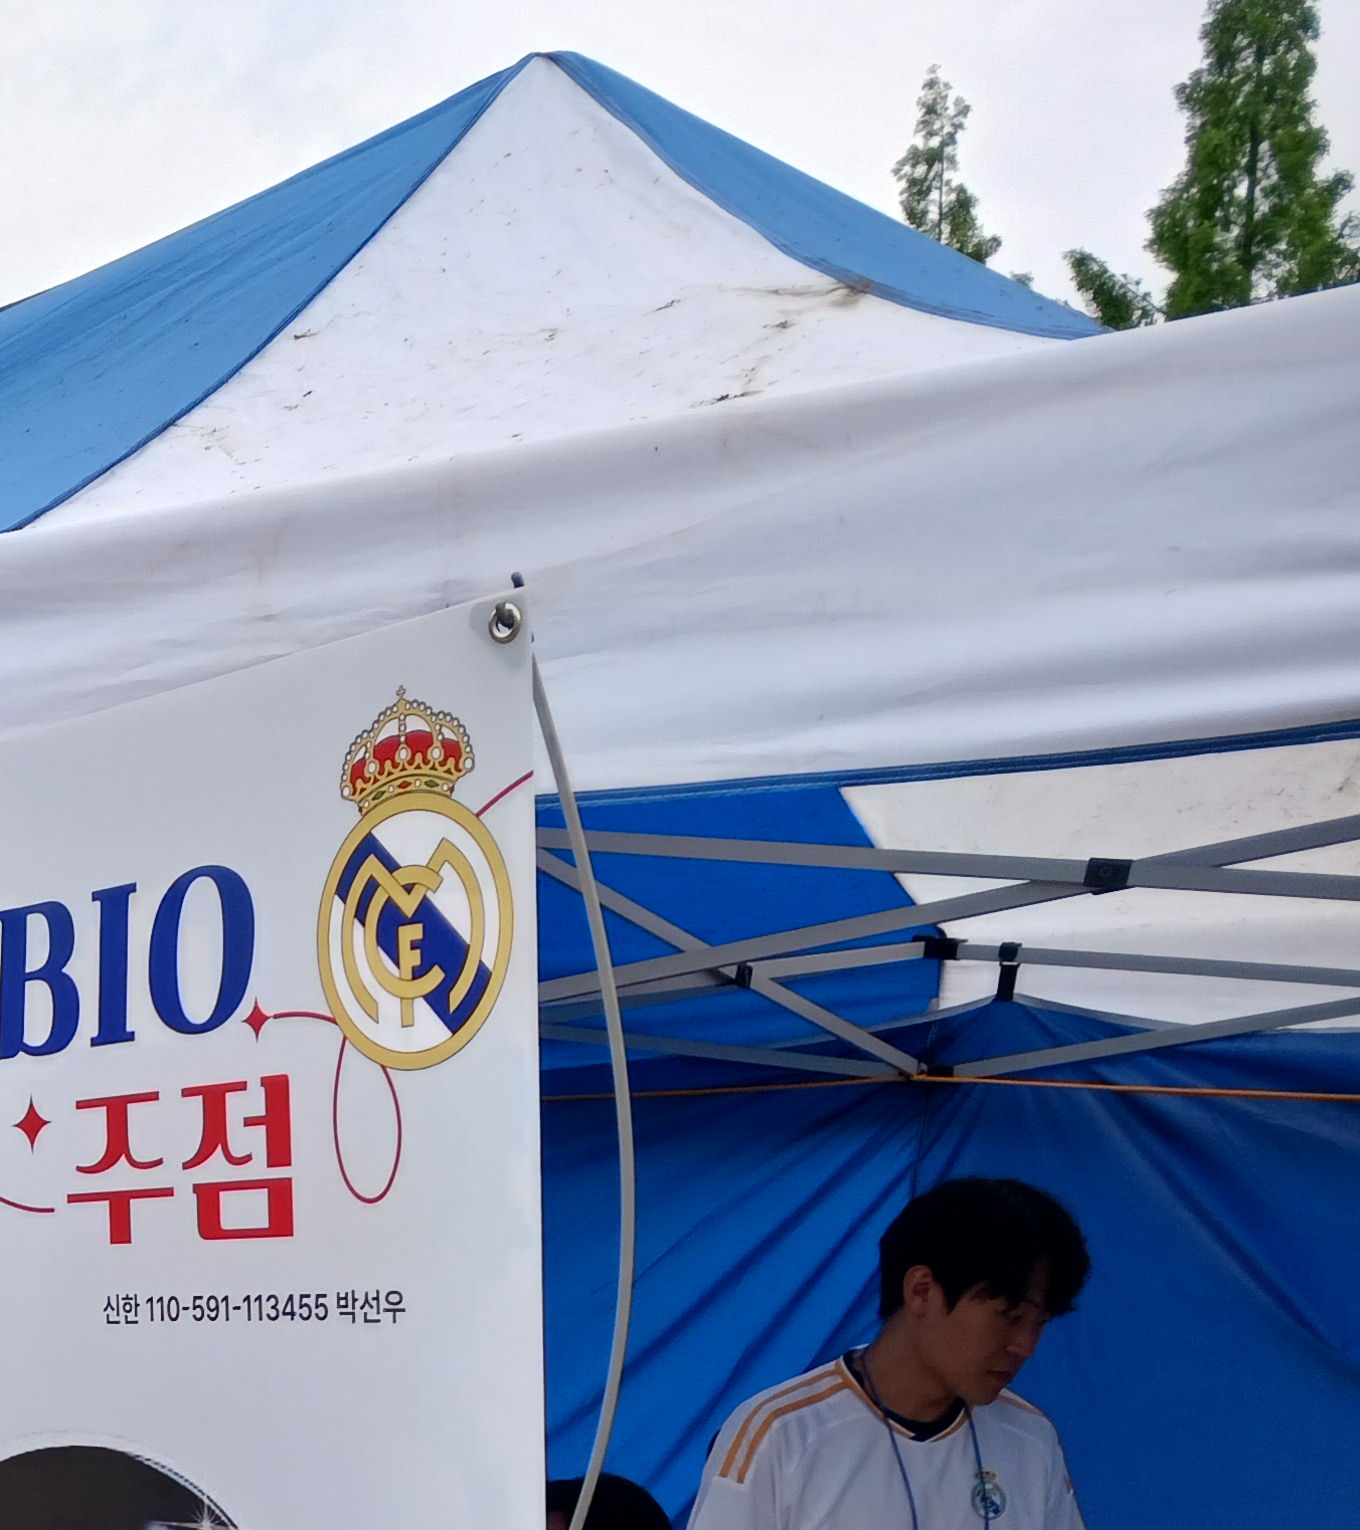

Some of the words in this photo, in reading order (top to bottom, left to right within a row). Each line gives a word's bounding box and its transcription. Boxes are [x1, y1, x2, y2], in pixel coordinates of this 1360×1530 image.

[66, 1074, 295, 1245] 주점
[102, 1293, 141, 1325] 신한
[145, 1293, 330, 1323] 110-591-113455
[335, 1289, 407, 1325] 박선우
